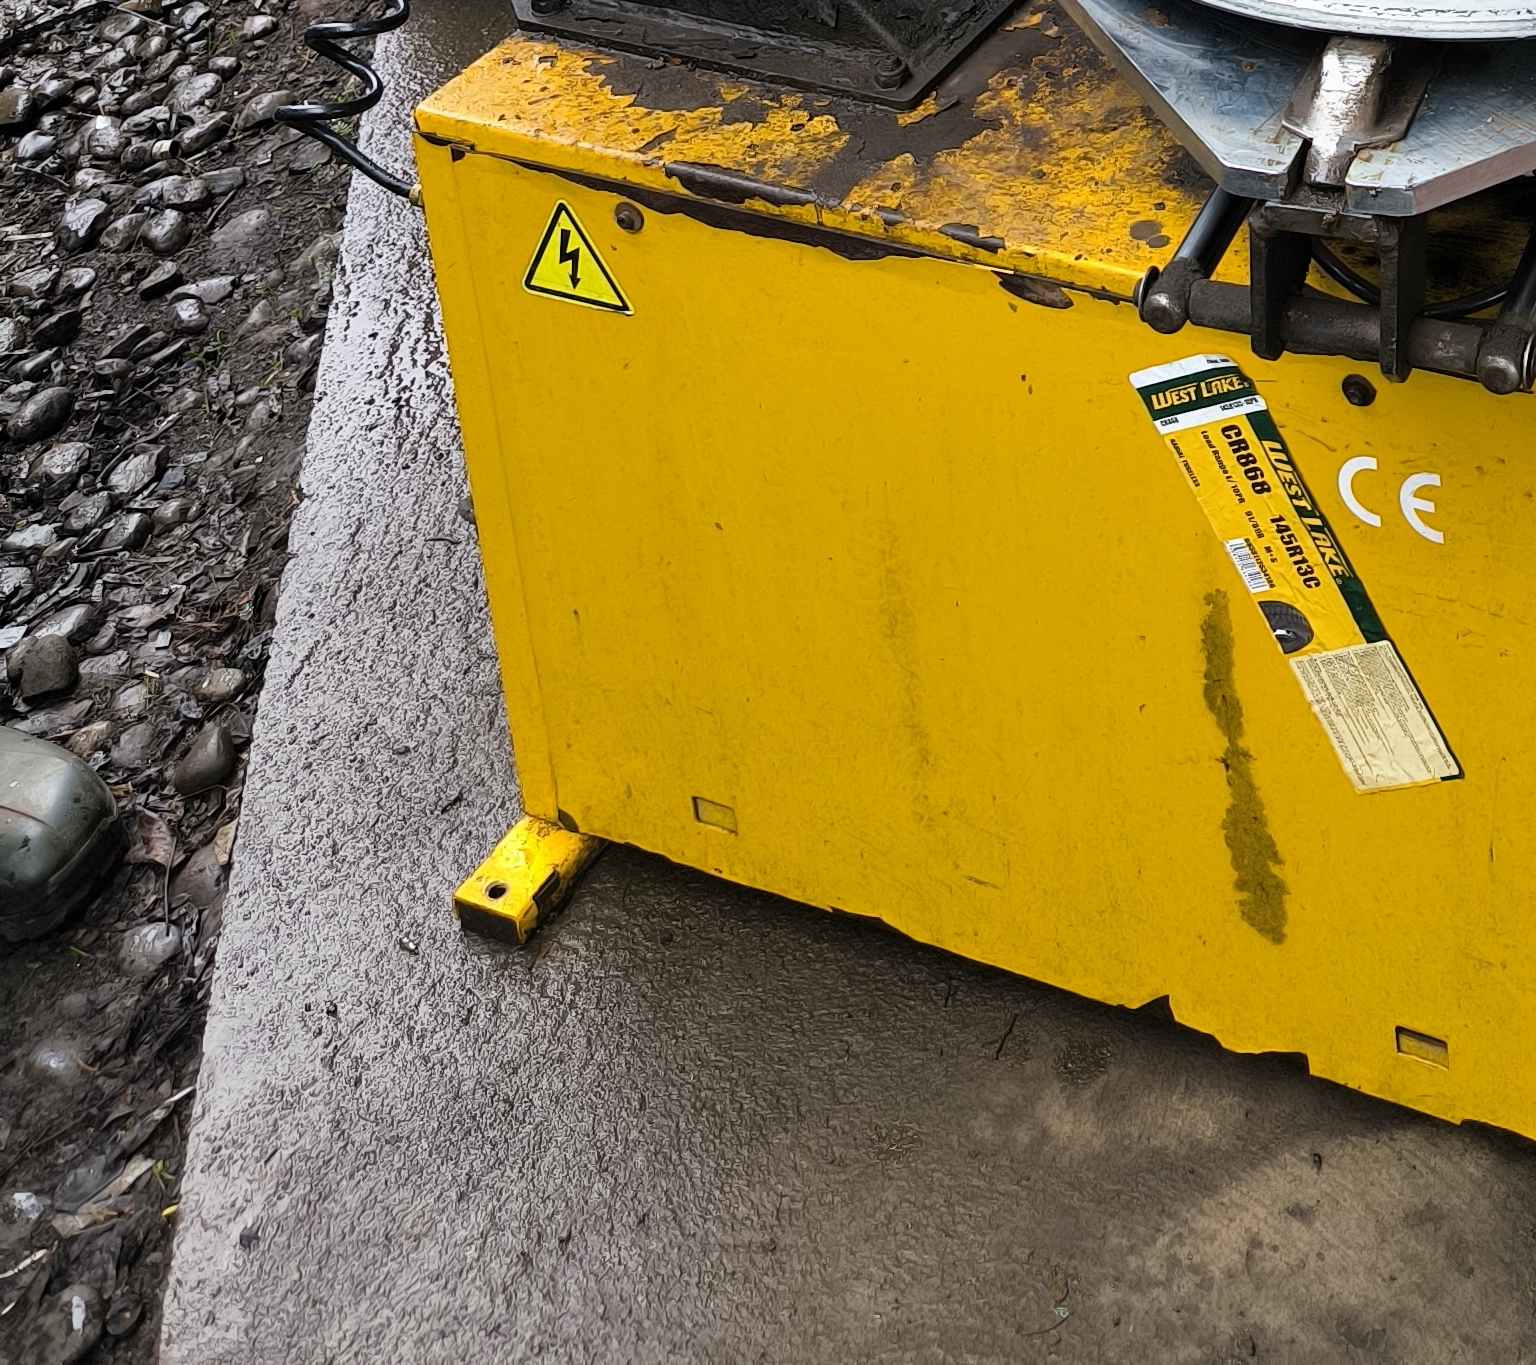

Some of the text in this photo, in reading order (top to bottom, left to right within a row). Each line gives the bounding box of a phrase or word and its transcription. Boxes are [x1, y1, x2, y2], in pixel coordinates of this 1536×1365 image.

[1151, 382, 1198, 410] WEST
[1200, 374, 1244, 398] LAKE
[1220, 424, 1272, 495] CR868
[1269, 513, 1321, 590] 145R13C
[1260, 439, 1317, 516] WEST
[1301, 517, 1353, 578] LAKE
[1338, 456, 1445, 545] CE
